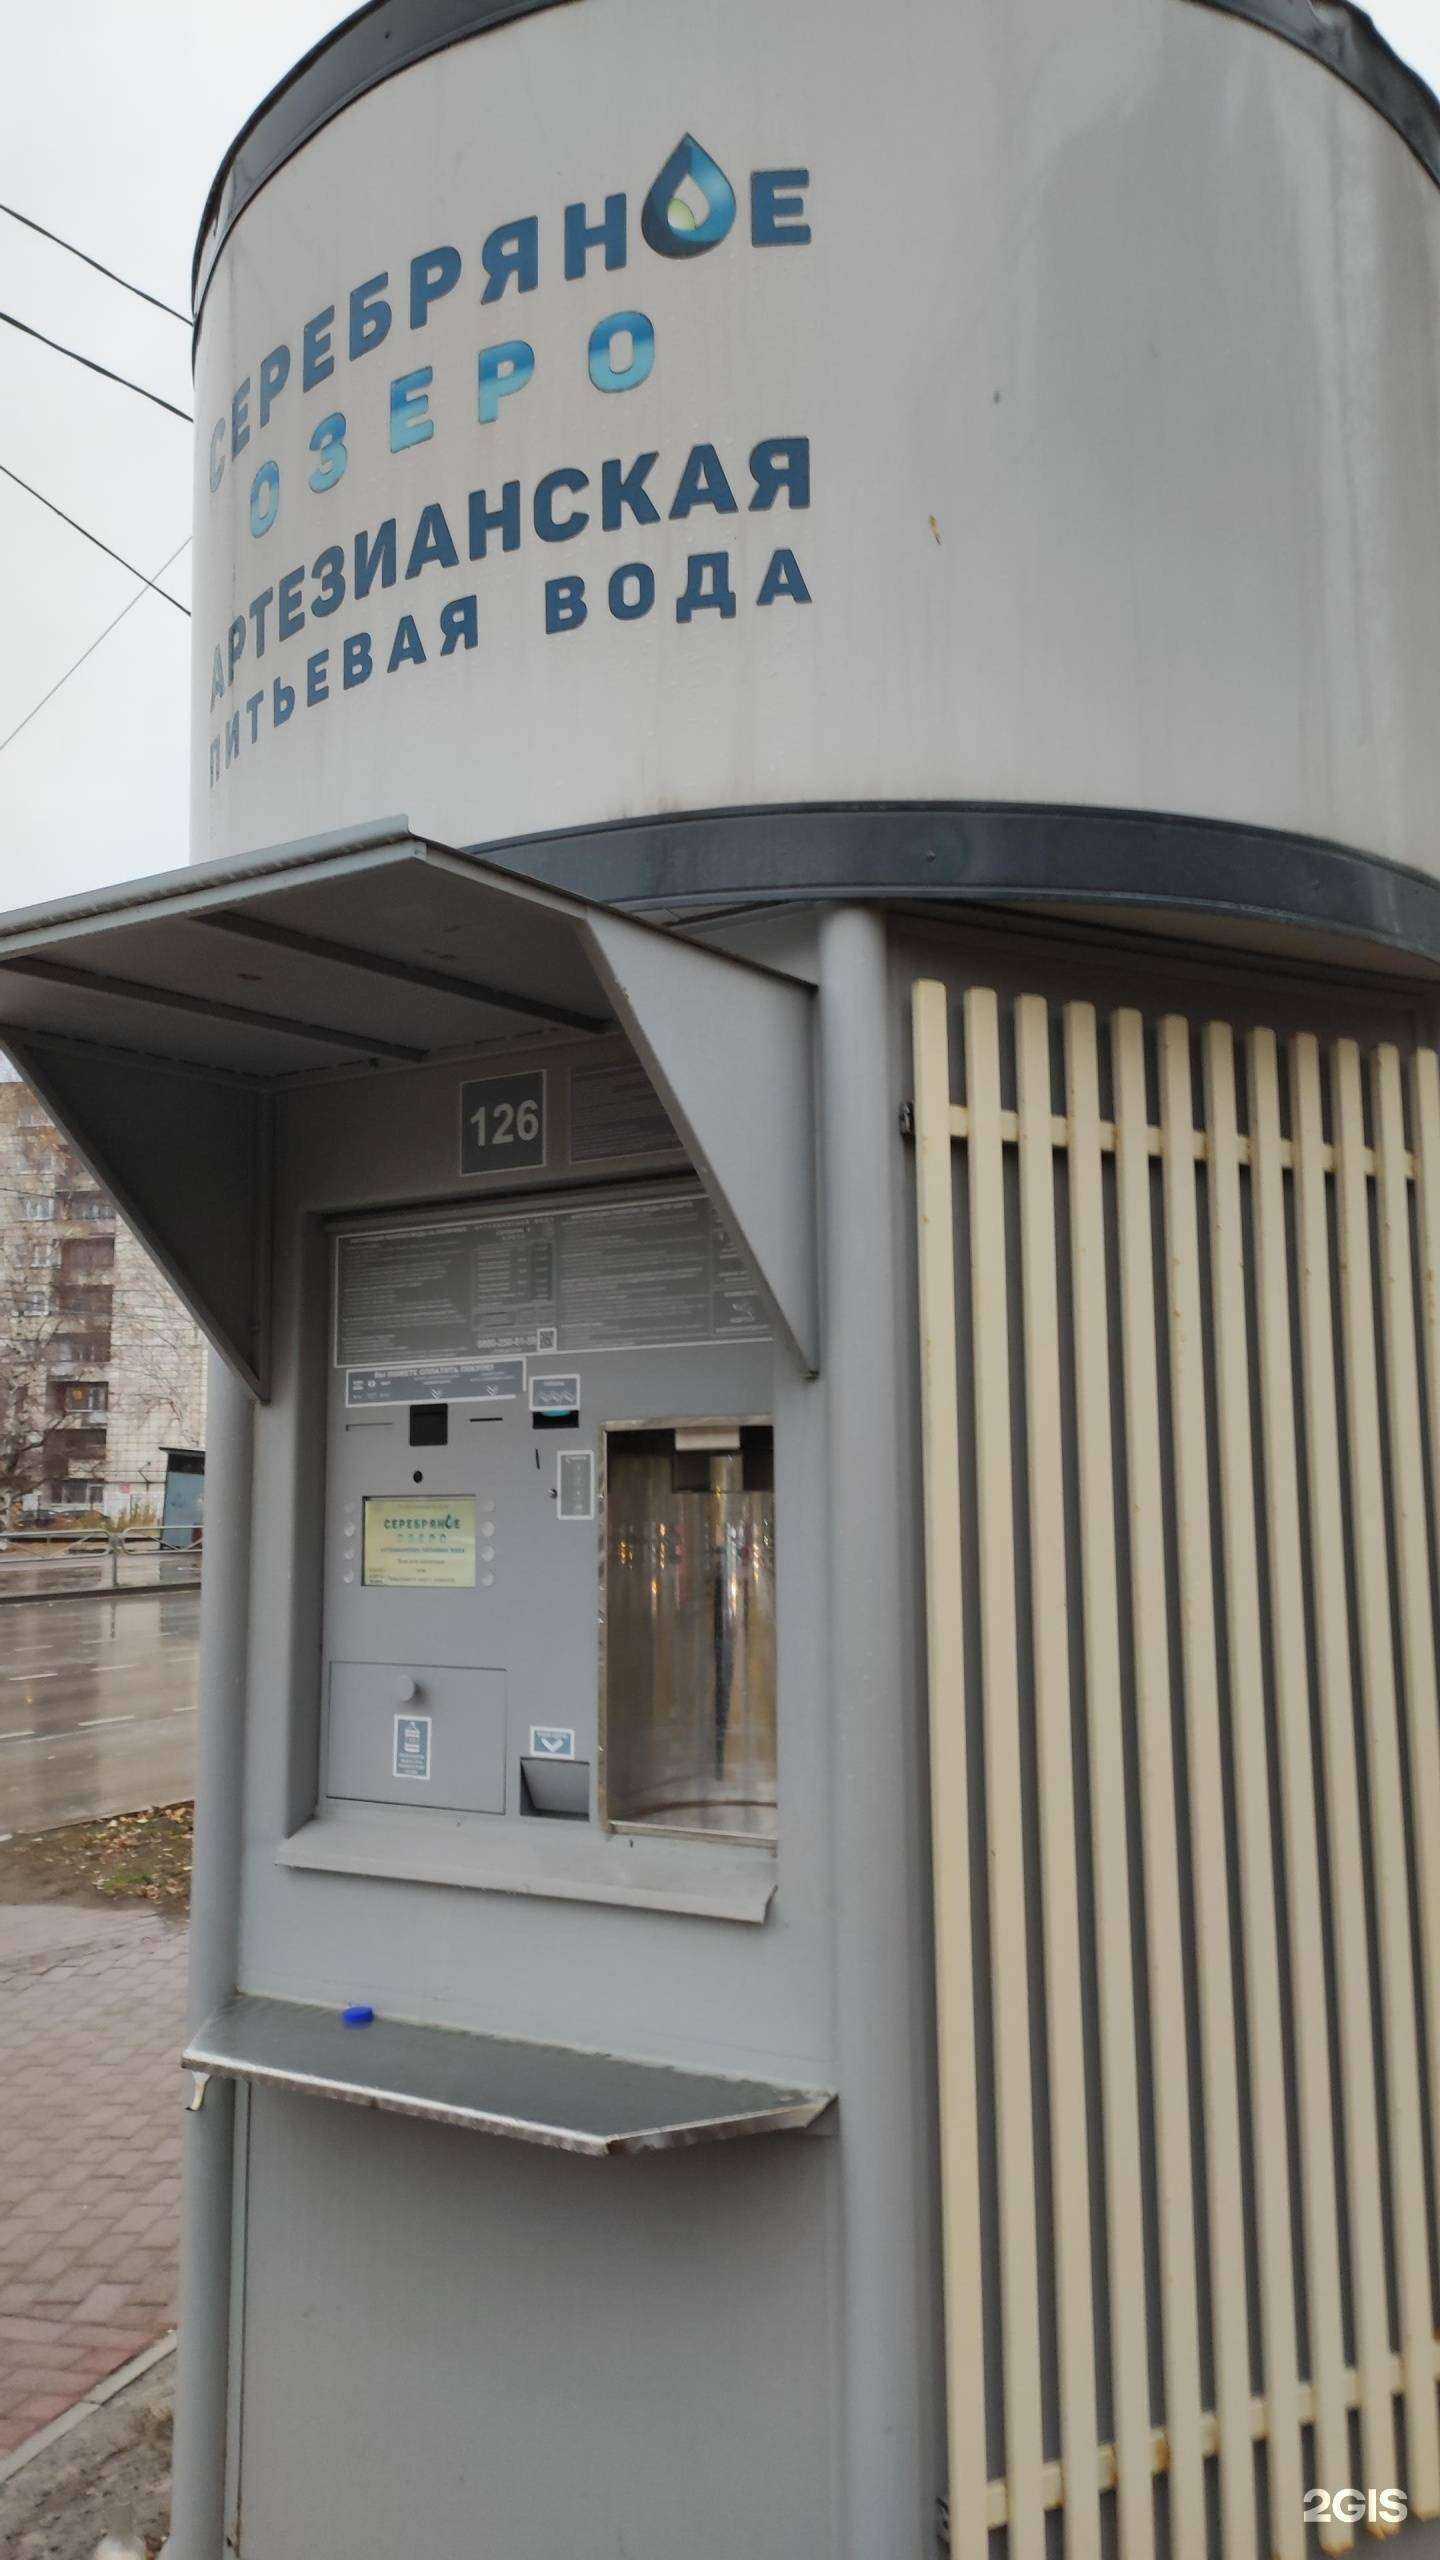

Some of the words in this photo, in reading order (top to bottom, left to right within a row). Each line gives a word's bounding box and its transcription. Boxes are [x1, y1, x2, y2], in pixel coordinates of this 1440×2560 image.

[208, 132, 812, 494] СЕРЕБРЯНОЕ
[250, 310, 655, 539] ОЗЕРО
[209, 436, 811, 714] АРТЕЗИАНСКАЯ
[209, 594, 479, 789] ПИТЬЕВАЯ
[545, 548, 812, 635] ВОДА
[470, 1100, 539, 1147] 126
